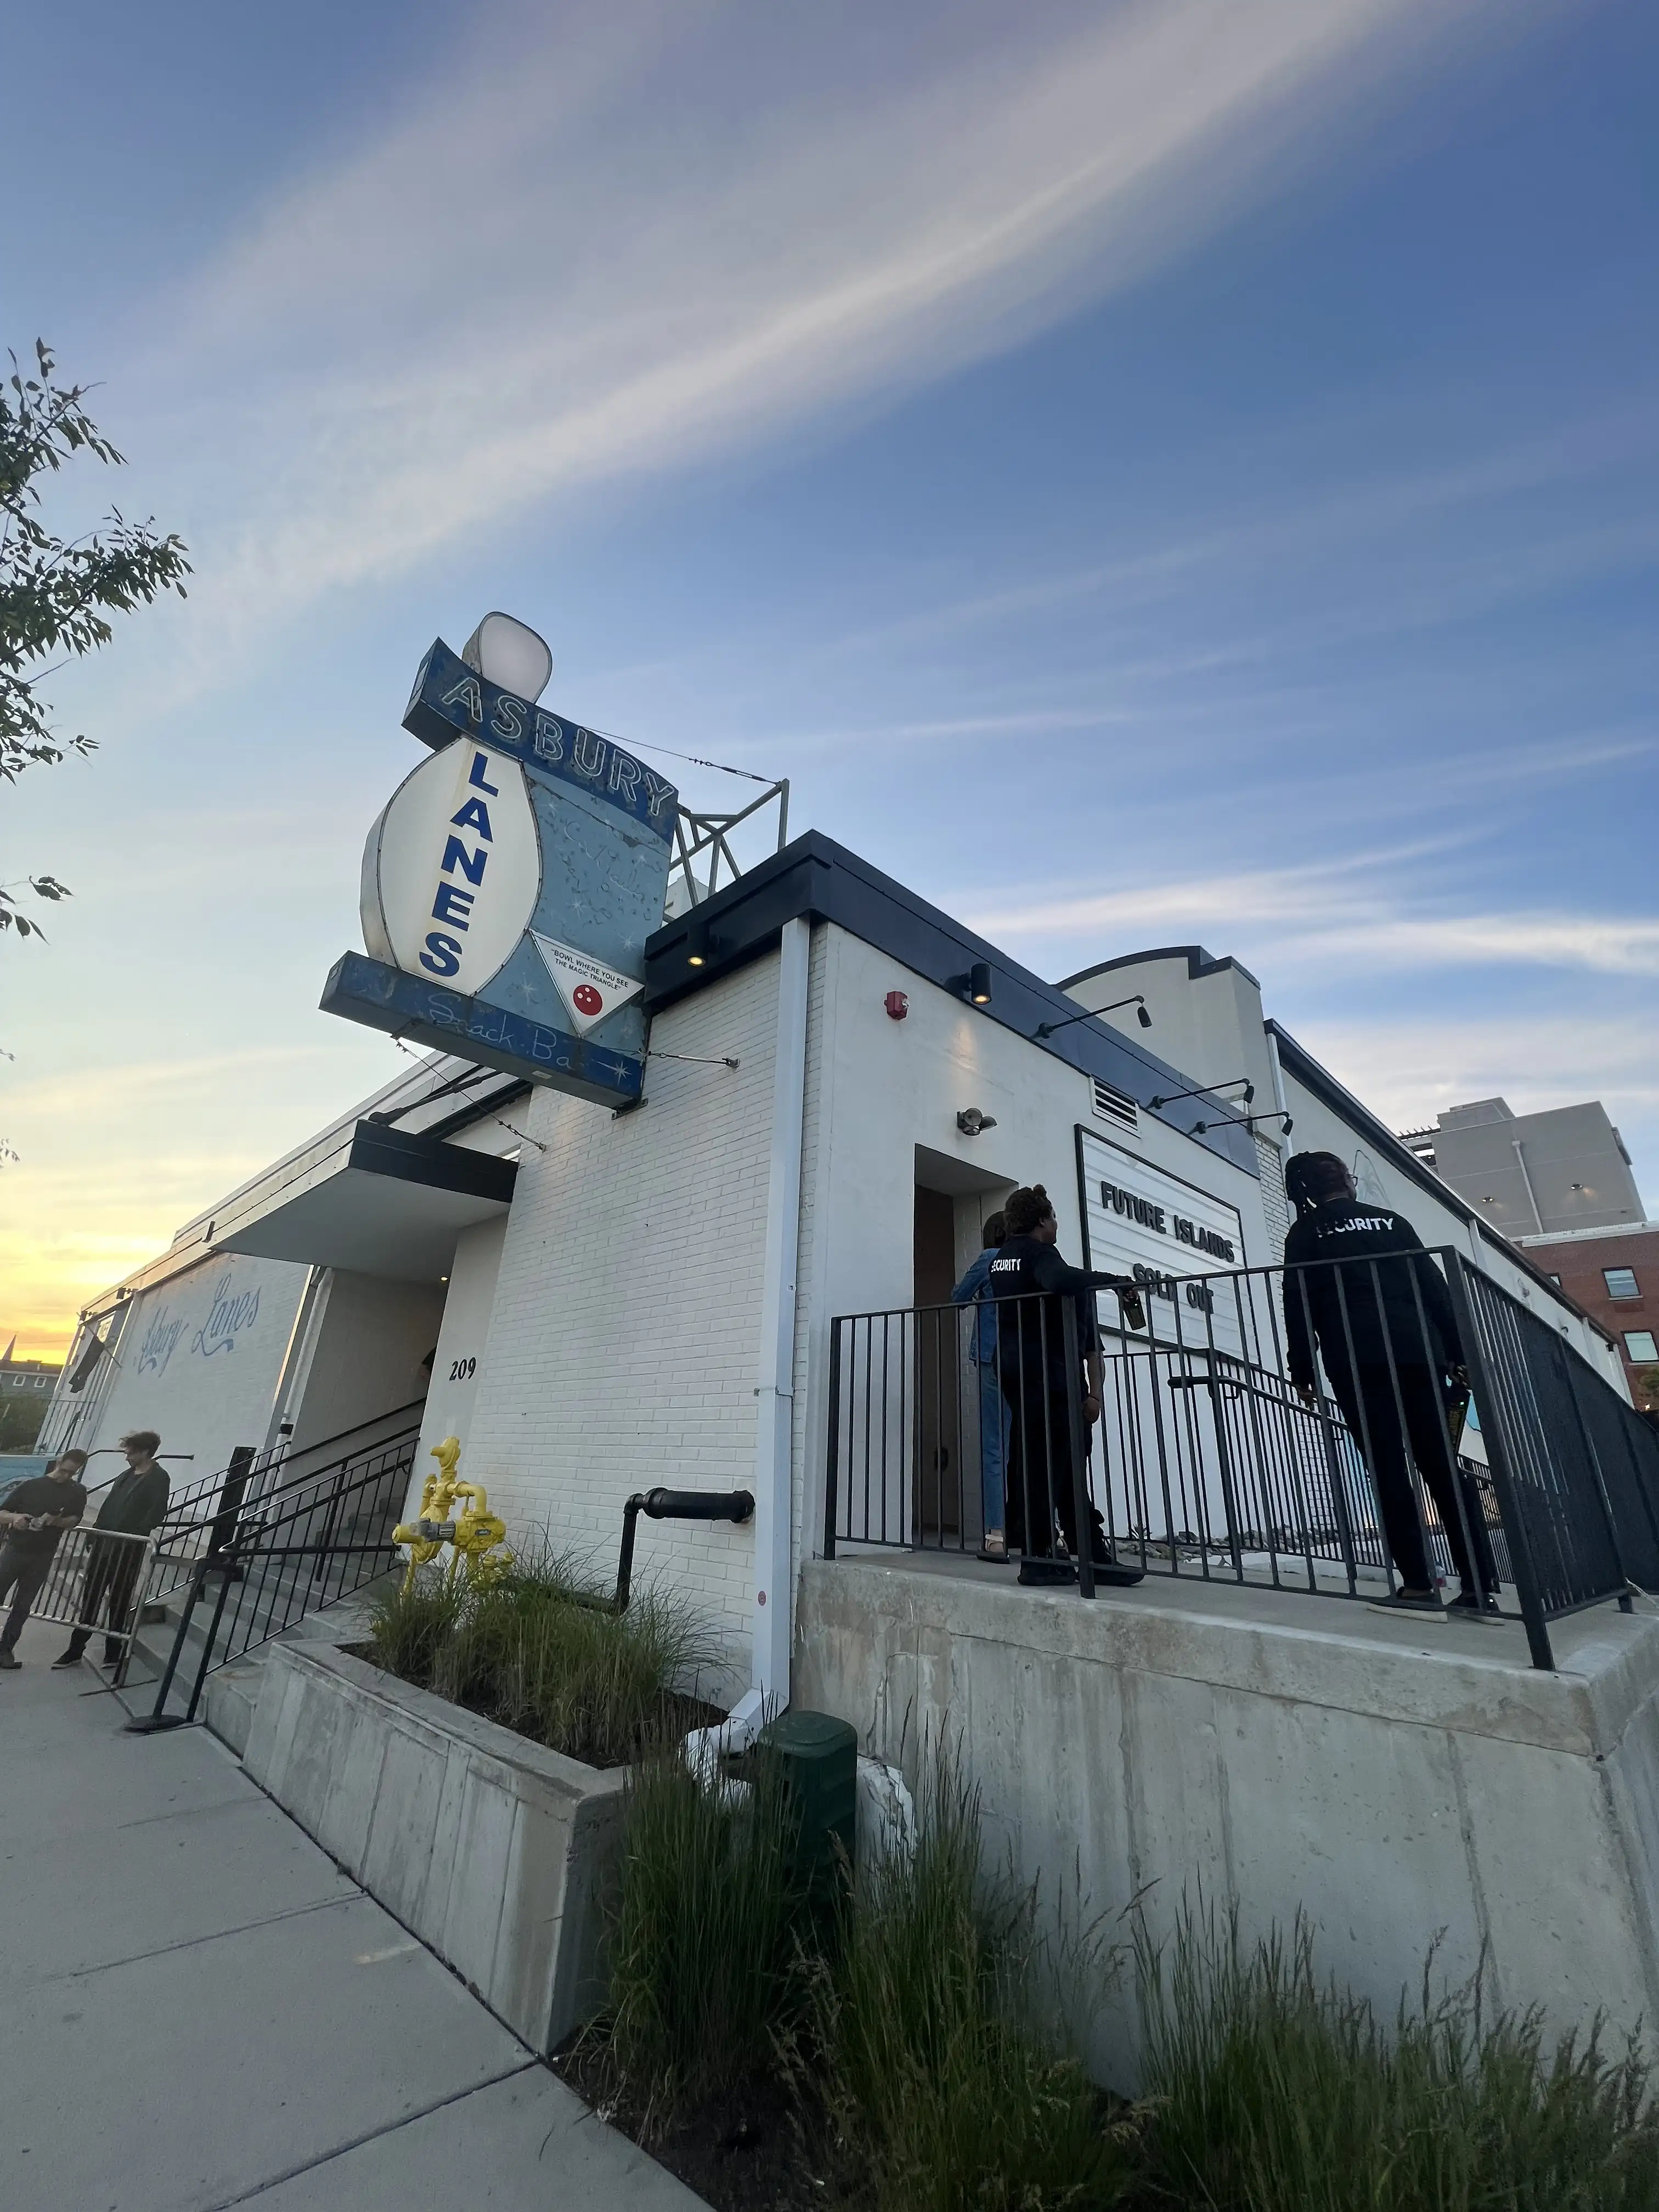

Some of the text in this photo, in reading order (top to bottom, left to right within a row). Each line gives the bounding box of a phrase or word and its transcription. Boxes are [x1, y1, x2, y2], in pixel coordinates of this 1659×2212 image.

[442, 677, 674, 816] ASBURY
[419, 751, 499, 977] LANES
[555, 958, 567, 968] THE
[568, 964, 588, 977] MAGIC
[576, 960, 600, 974] WHERE
[602, 970, 615, 981] YOU
[616, 978, 628, 988] SEE
[1101, 1181, 1235, 1263] FUTURE ISLANDS
[191, 1273, 262, 1356] Lanes
[1186, 1283, 1214, 1314] OUT
[449, 1357, 476, 1381] 209
